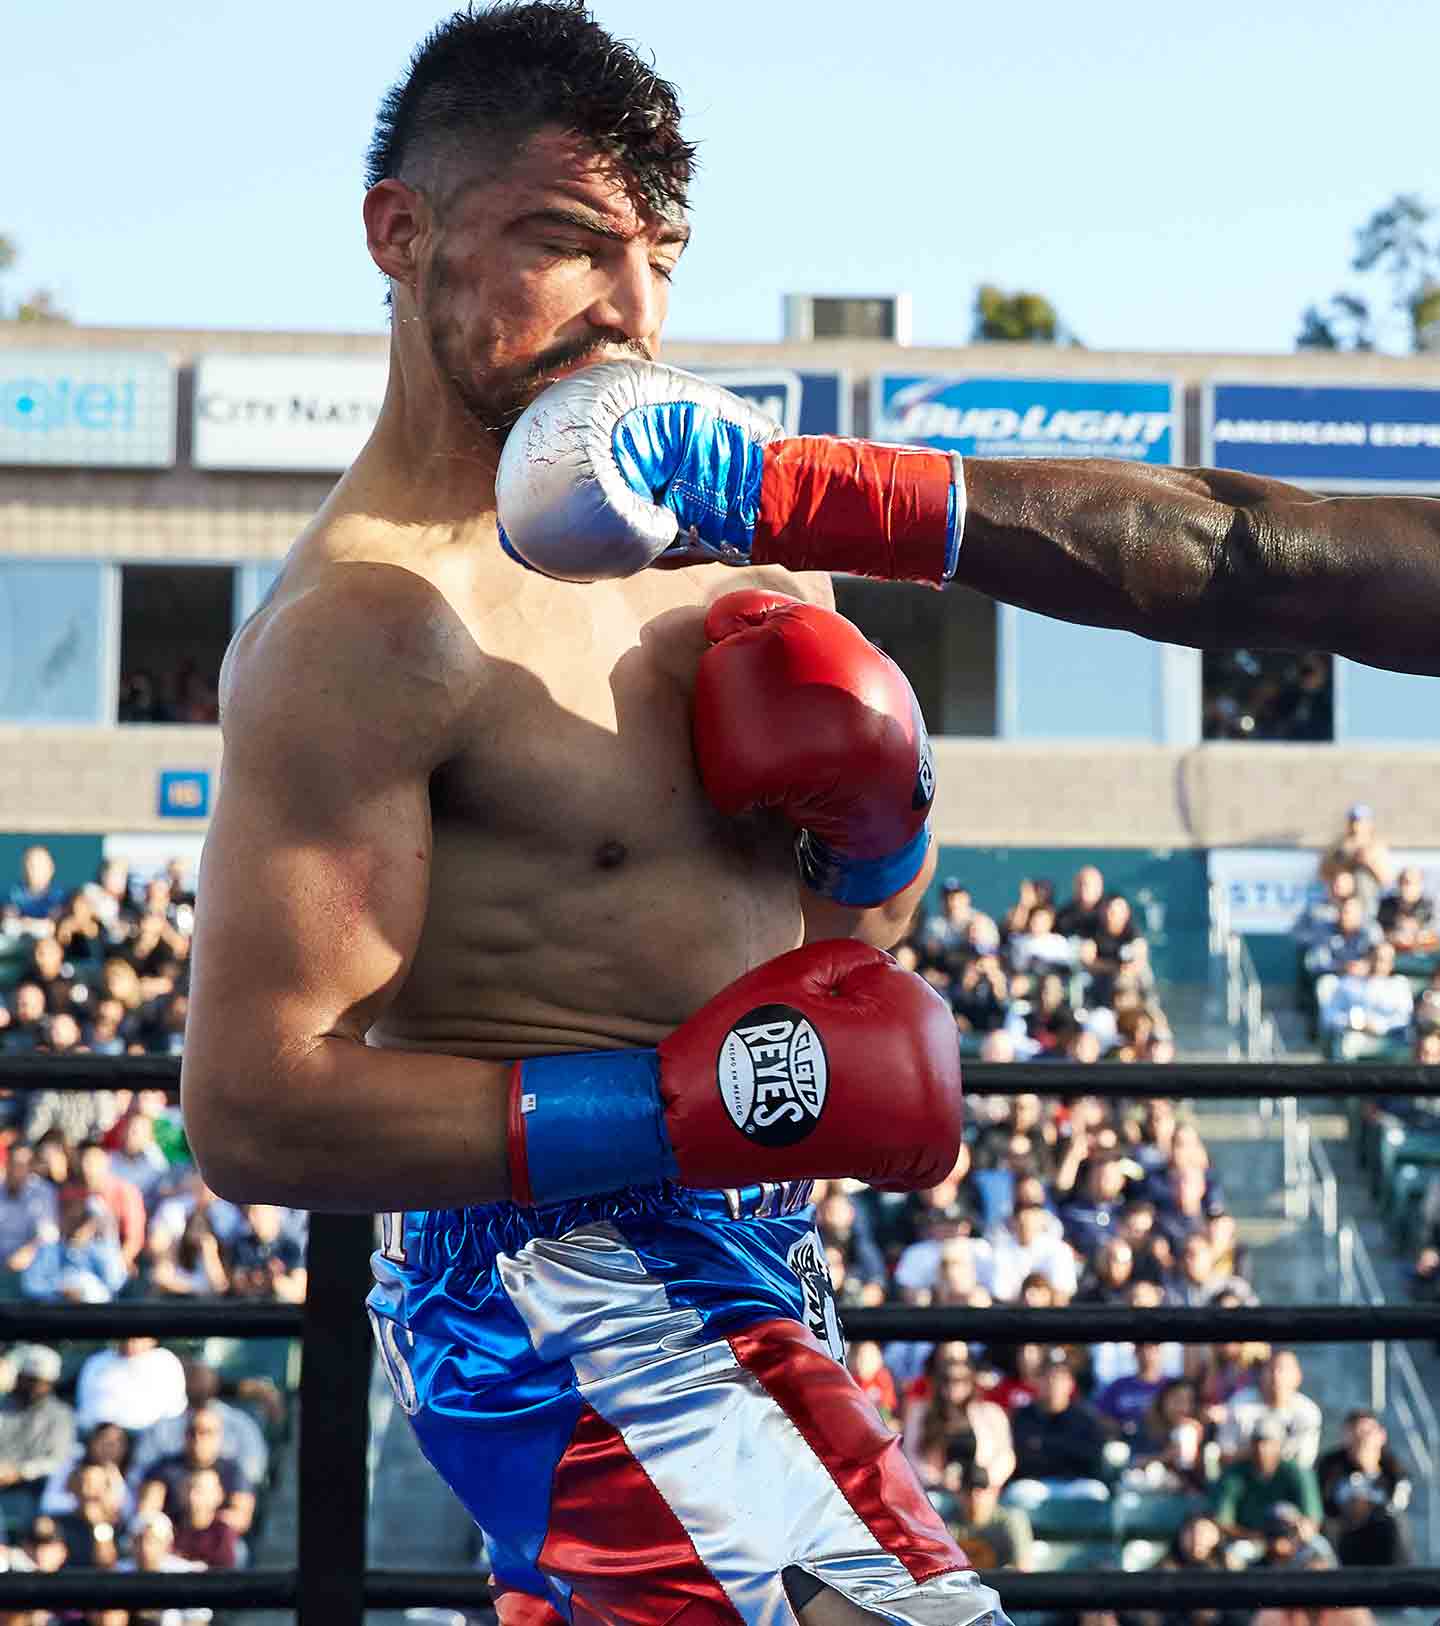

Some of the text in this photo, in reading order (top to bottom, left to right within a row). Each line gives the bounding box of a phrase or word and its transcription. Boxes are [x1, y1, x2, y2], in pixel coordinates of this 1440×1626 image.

[1215, 419, 1366, 445] AMERICAN
[735, 1020, 804, 1127] REYES
[794, 1030, 819, 1106] CLETO
[733, 1084, 743, 1116] MEXICO
